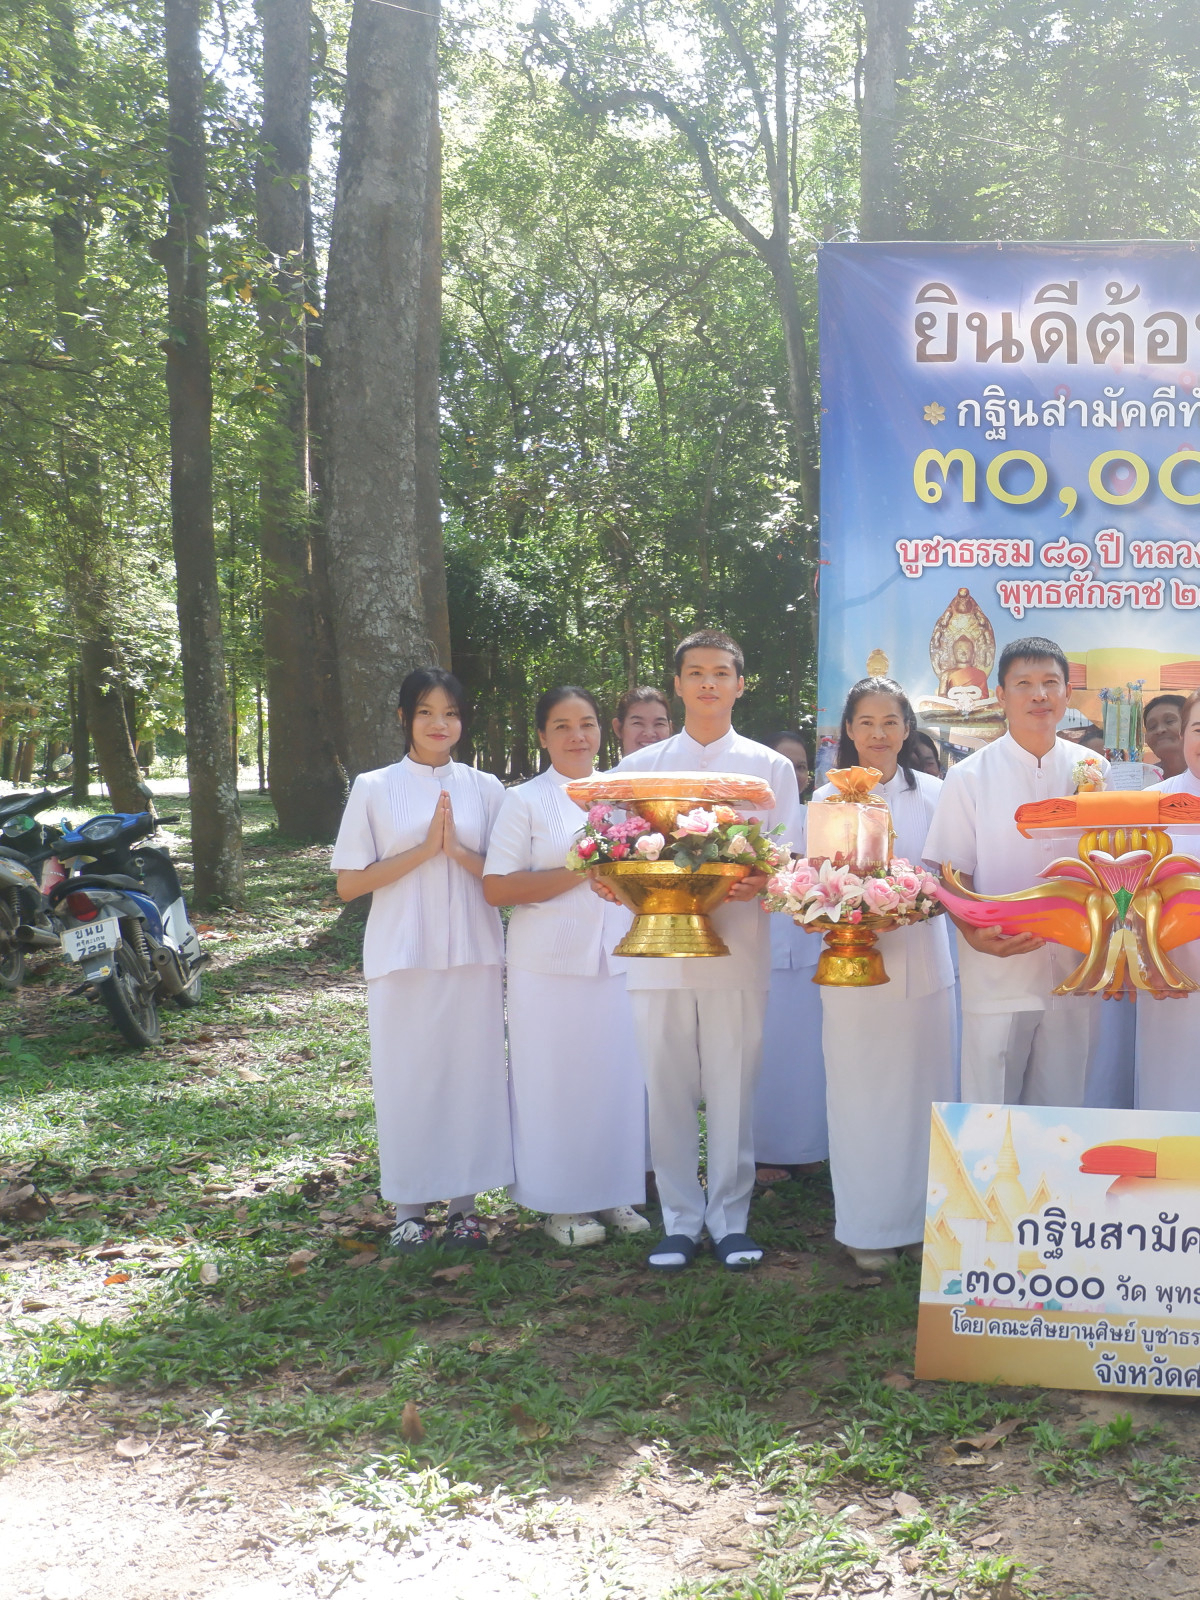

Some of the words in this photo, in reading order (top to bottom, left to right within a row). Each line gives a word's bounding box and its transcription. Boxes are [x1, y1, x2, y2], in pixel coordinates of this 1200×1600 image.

[898, 538, 1032, 576] บูชาธรรม
[1042, 539, 1090, 567] ๘๑
[1098, 531, 1122, 565] ปี
[998, 573, 1163, 616] พุทธศักราช
[966, 1269, 1106, 1302] ๓๐,๐๐๐
[1115, 1273, 1147, 1303] วัด
[951, 1308, 984, 1334] โดย
[988, 1316, 1136, 1349] คณะศิษยานุศิษย์
